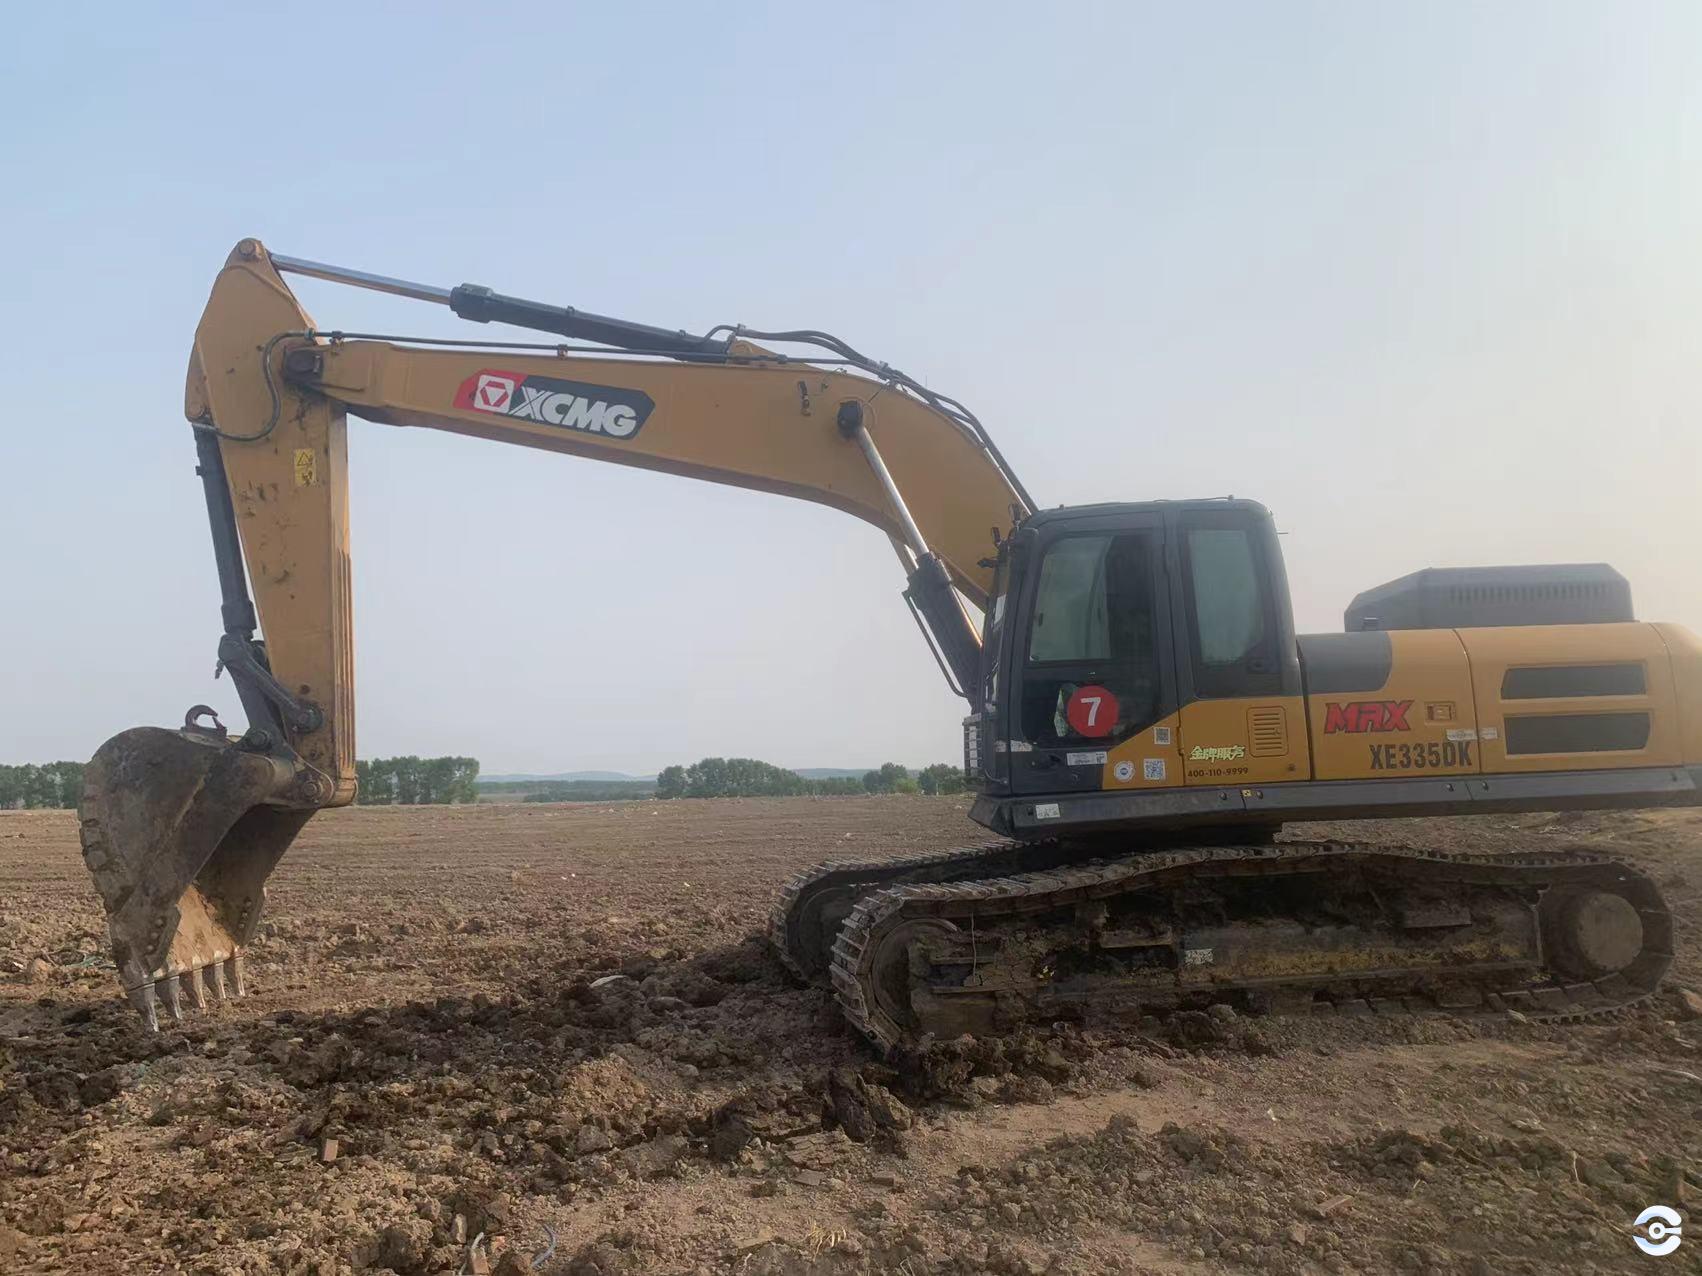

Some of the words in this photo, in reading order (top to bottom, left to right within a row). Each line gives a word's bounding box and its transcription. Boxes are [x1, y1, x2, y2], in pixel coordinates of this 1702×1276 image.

[509, 386, 637, 436] XCMG
[1080, 697, 1102, 726] 7
[1325, 700, 1414, 733] MAX
[1190, 746, 1245, 763] 金牌服务
[1188, 767, 1248, 777] 400-110-9999
